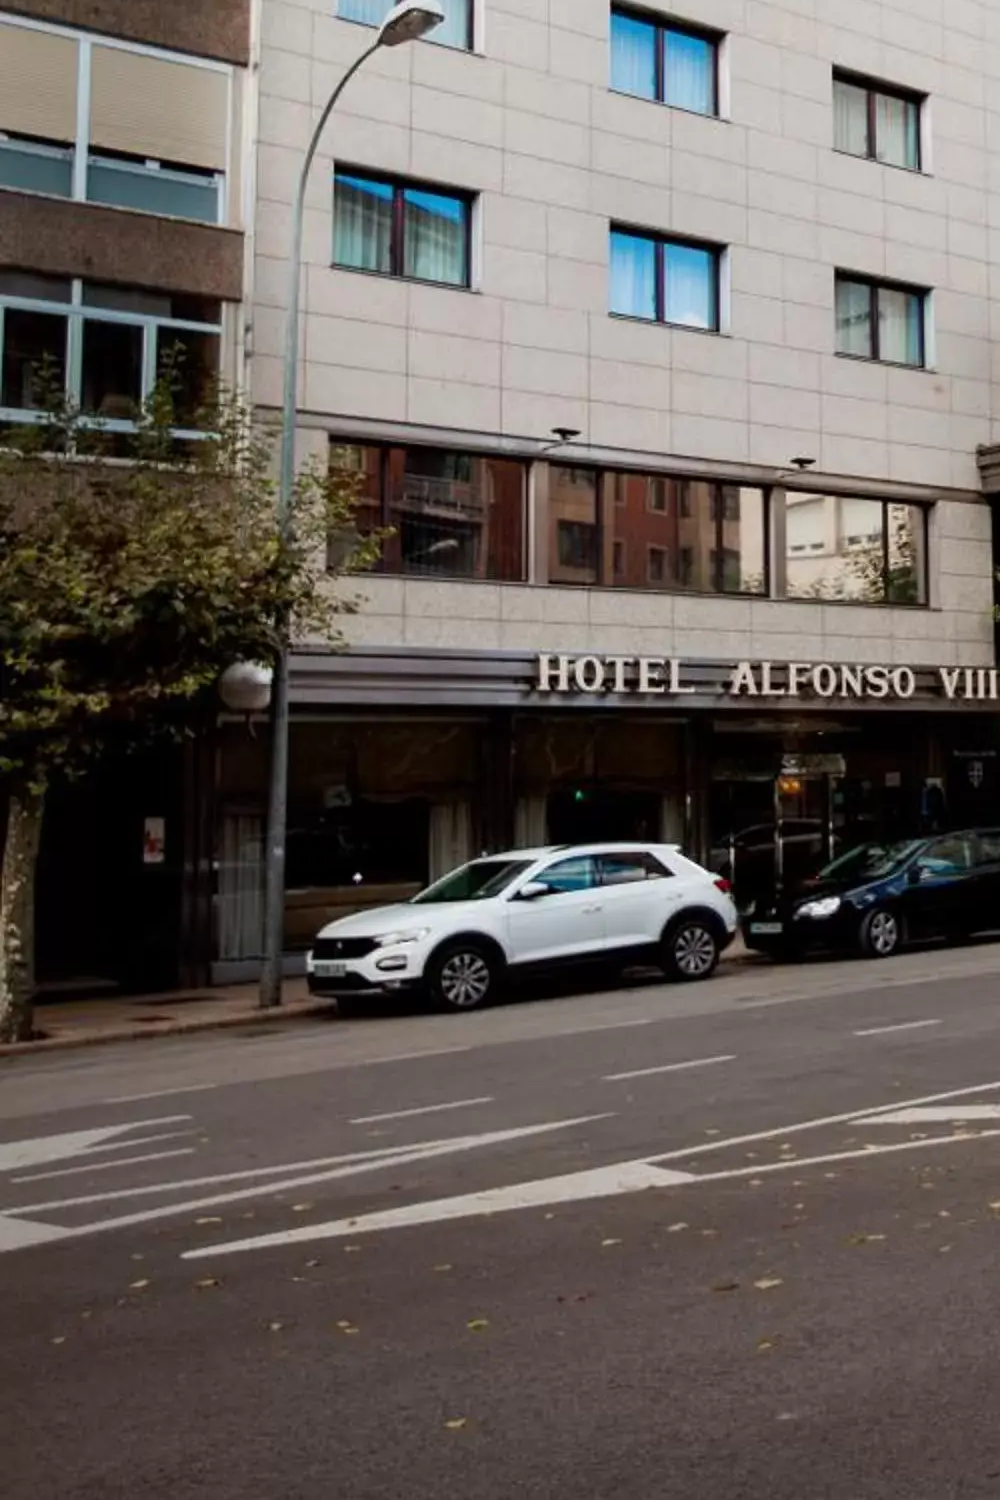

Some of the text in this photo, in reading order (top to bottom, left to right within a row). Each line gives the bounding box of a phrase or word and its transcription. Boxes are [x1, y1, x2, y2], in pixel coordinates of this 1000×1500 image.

[537, 654, 998, 699] HOTEL ALFONSO VIII
